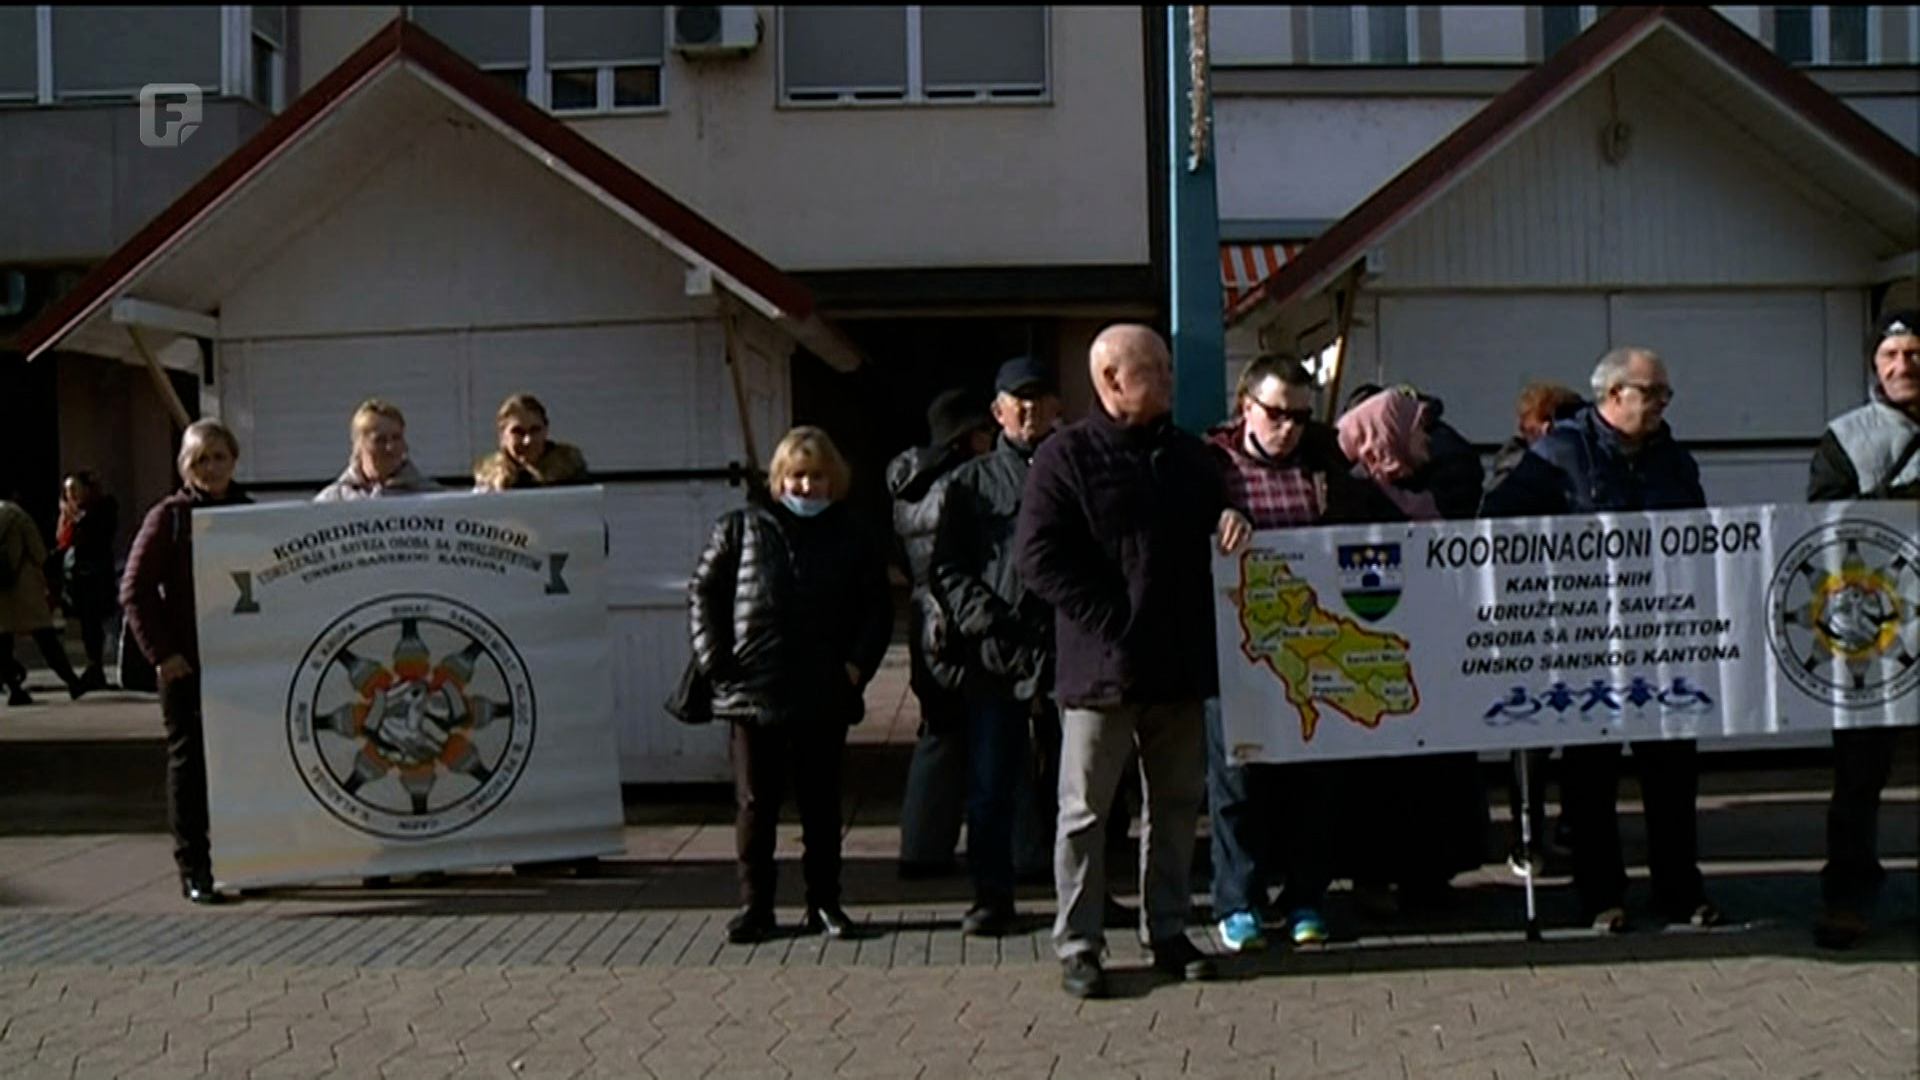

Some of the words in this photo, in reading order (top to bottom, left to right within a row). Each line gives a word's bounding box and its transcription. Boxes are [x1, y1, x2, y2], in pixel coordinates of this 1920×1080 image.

[273, 515, 445, 560] KOORDINACIONI
[454, 518, 529, 549] ODBOR
[1660, 522, 1762, 557] ODBOR
[1506, 571, 1652, 594] KANTONALNIH
[1618, 594, 1696, 614] SAVEZA
[1466, 629, 1536, 649] OSOBA
[1543, 627, 1568, 645] SA
[1575, 619, 1731, 642] INVALIDITETOM
[1461, 655, 1534, 676] UNSKO
[1539, 648, 1637, 672] SANSKOG
[1642, 644, 1741, 666] KANTONA
